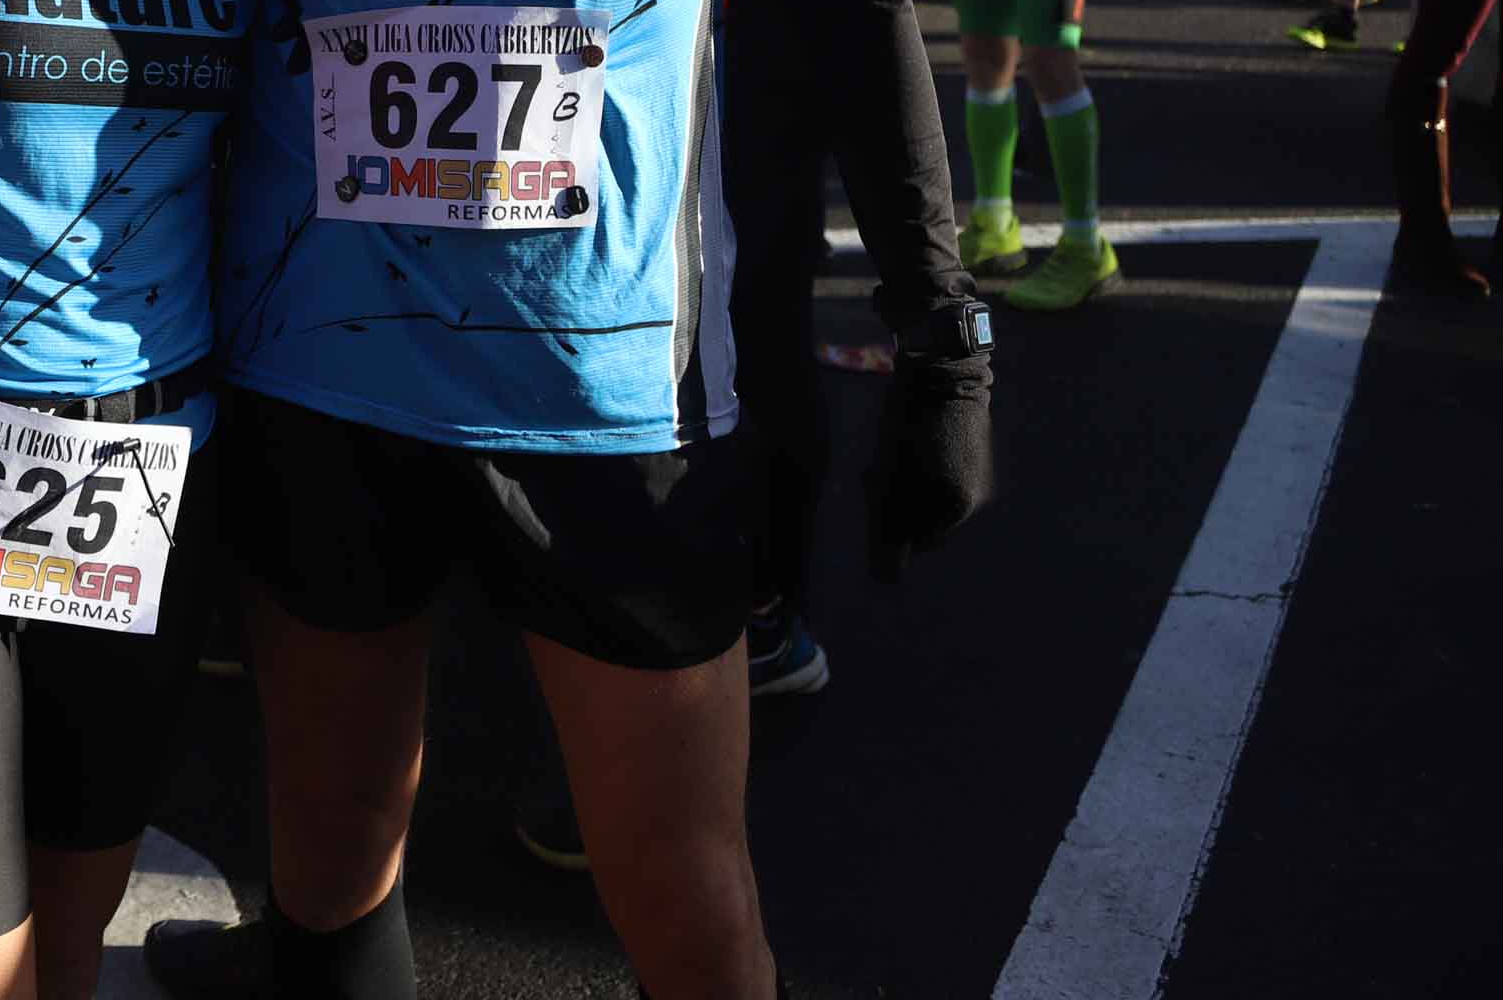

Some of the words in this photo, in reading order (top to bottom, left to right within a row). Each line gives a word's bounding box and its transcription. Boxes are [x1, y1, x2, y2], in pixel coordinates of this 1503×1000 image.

[374, 23, 412, 53] LIGA
[418, 23, 476, 55] CROSS
[480, 24, 596, 56] CABRERIZOS
[81, 49, 130, 84] de
[369, 61, 543, 151] 627
[16, 426, 77, 462] CROSS
[8, 593, 133, 625] REFORMAS
